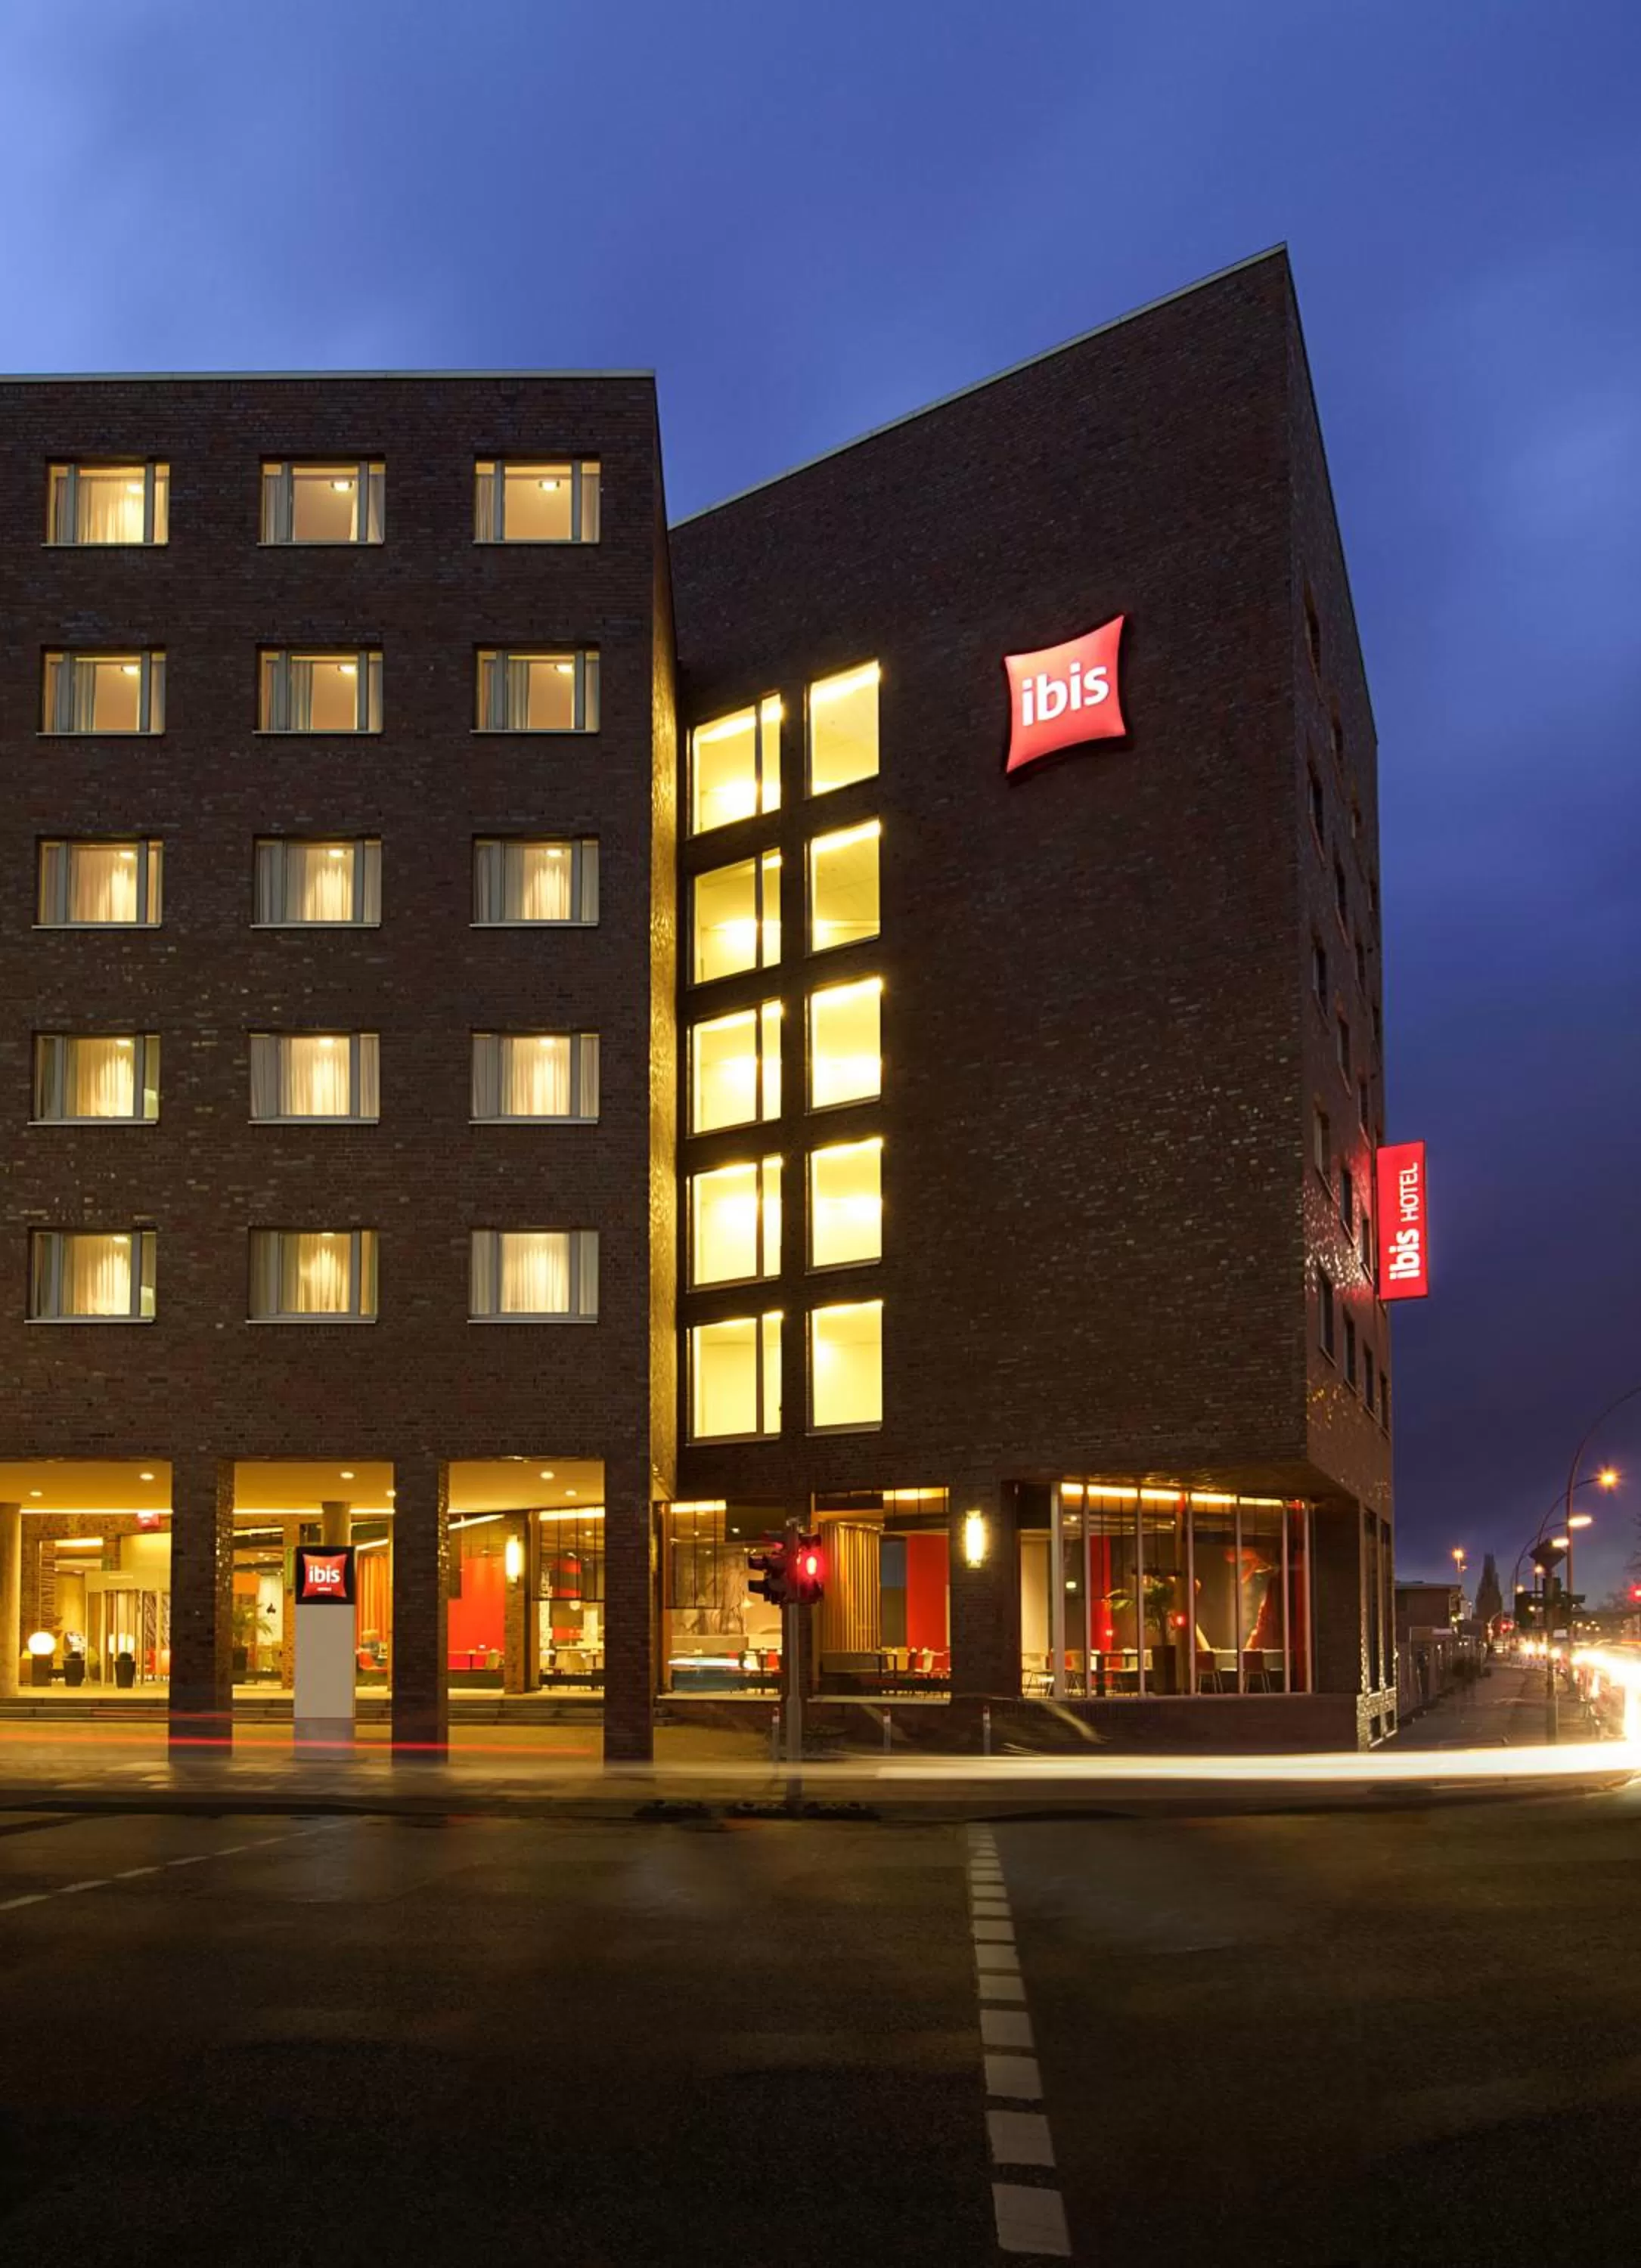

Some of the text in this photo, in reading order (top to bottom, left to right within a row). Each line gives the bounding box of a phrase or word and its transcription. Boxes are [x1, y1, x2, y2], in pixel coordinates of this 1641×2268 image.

[1022, 662, 1109, 727] ibis
[1389, 1161, 1420, 1280] ibis HOTEL
[309, 1564, 340, 1584] ibis
